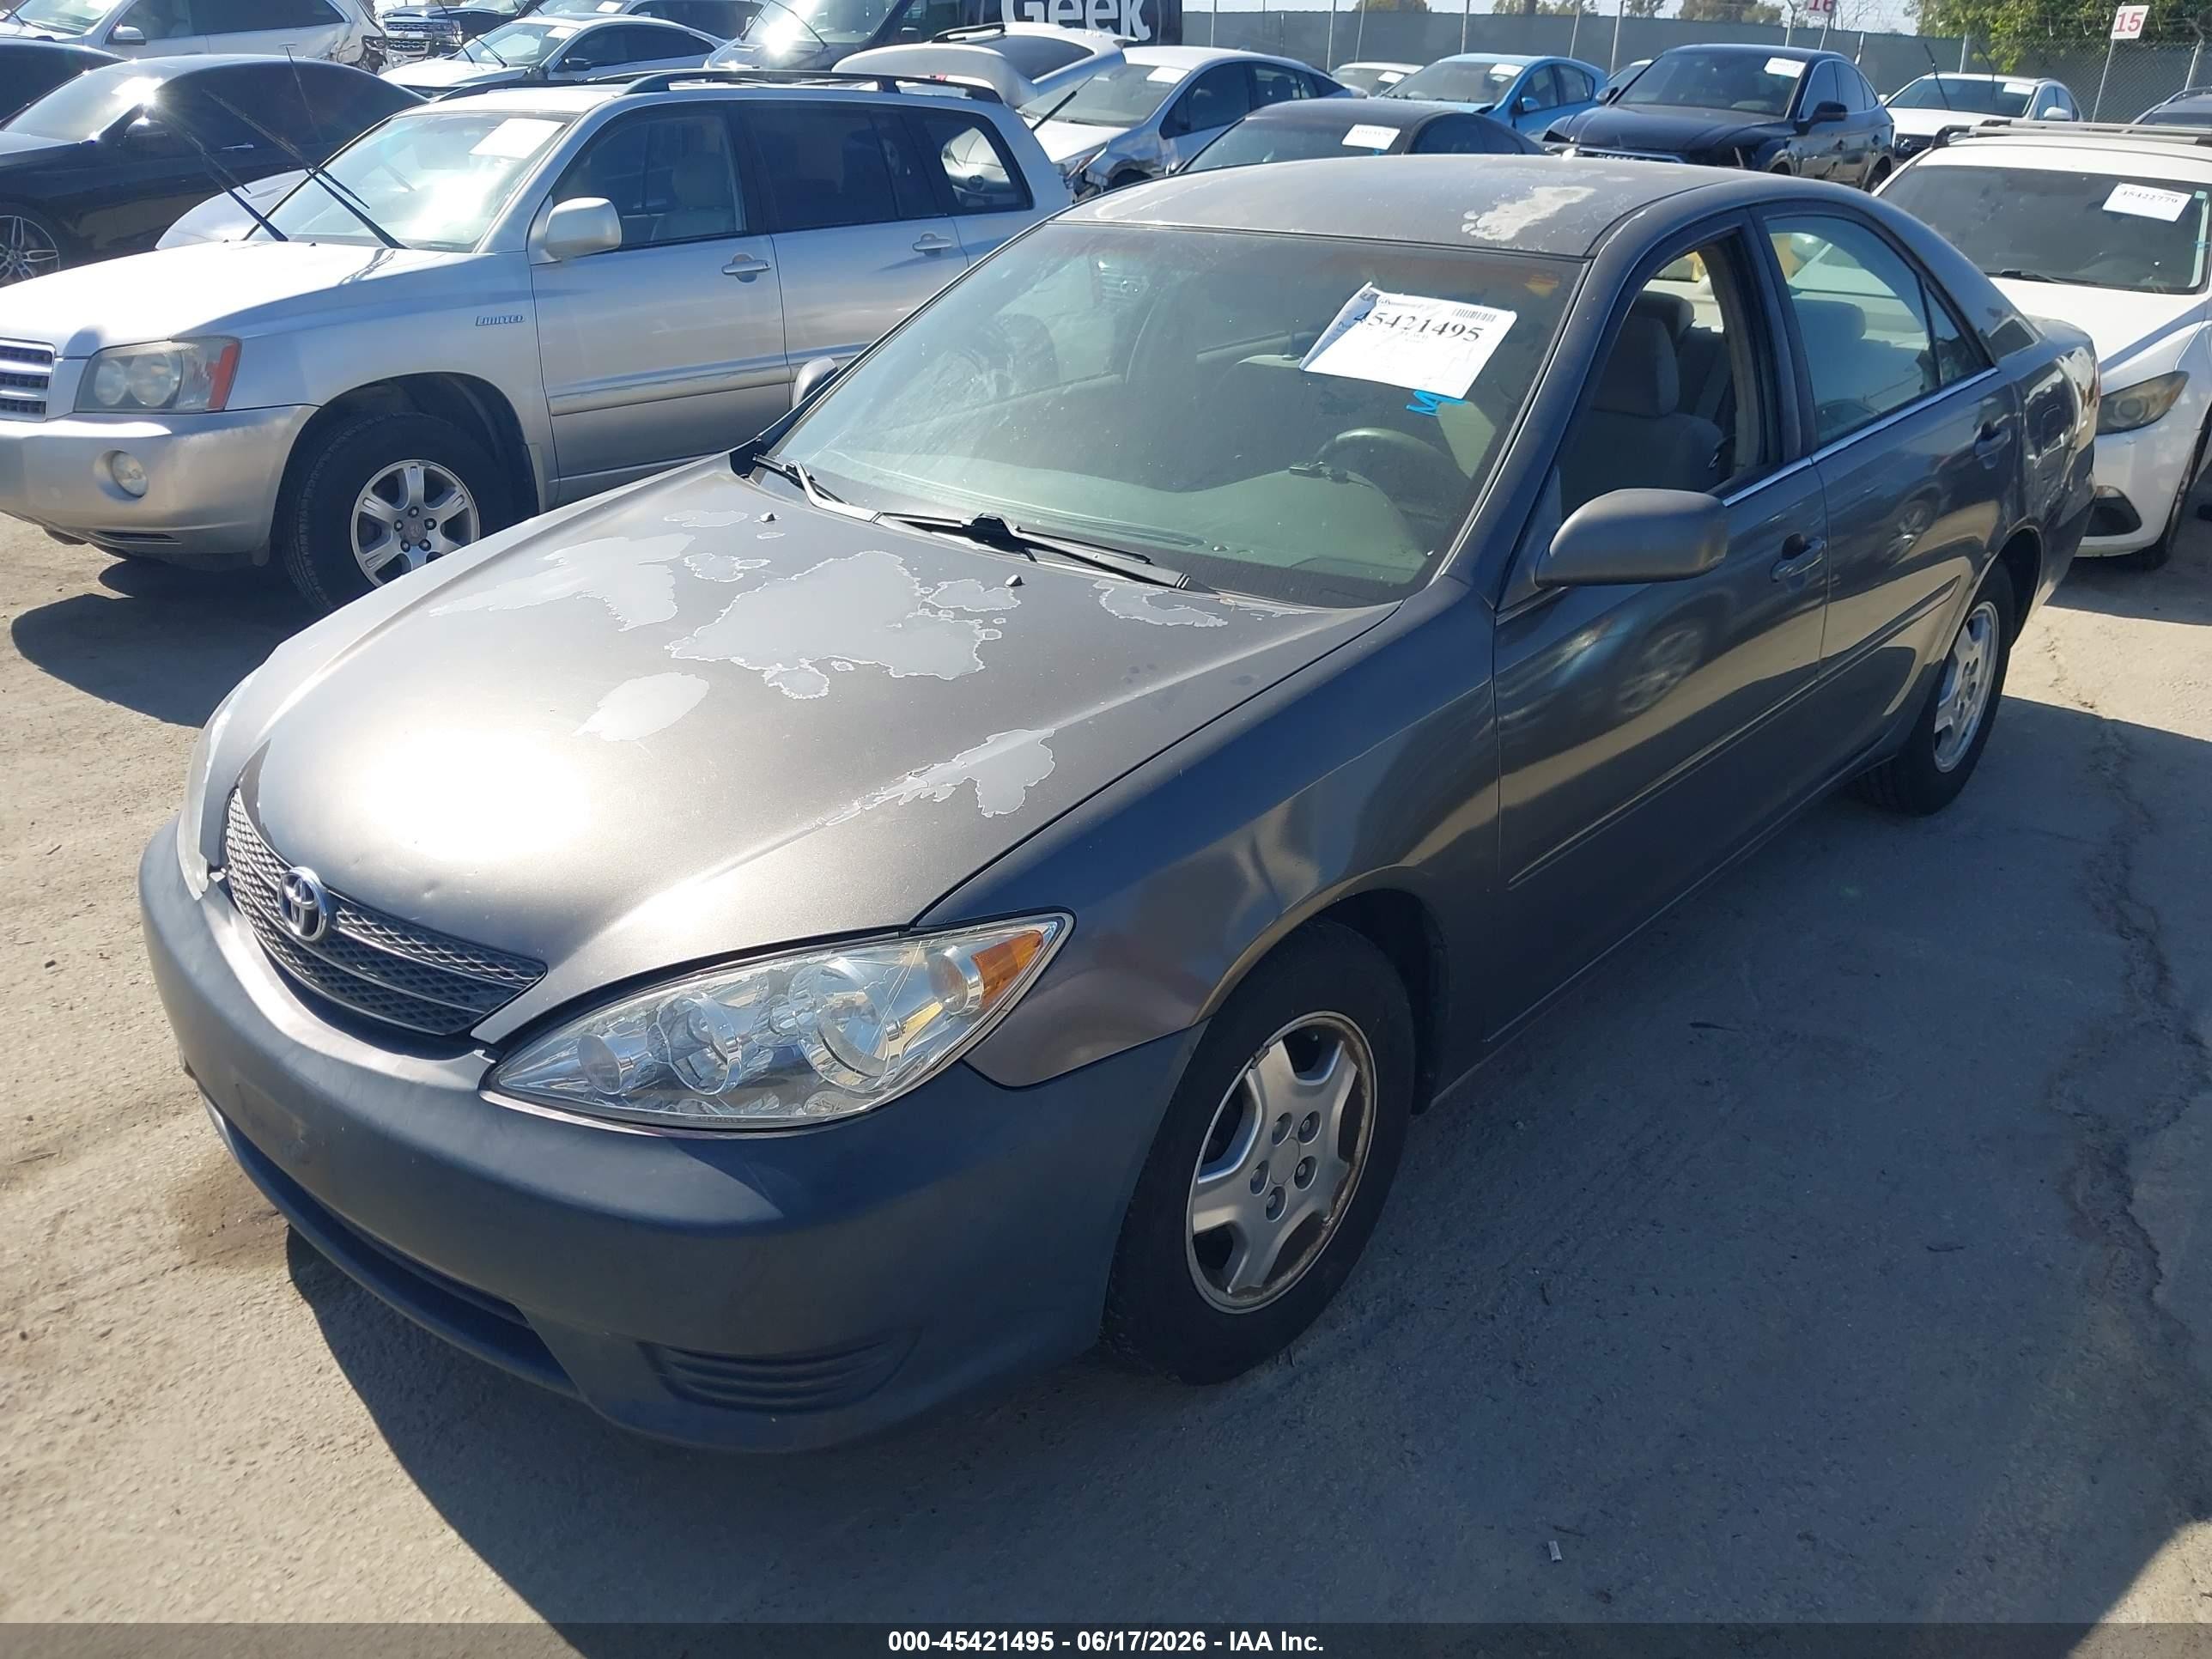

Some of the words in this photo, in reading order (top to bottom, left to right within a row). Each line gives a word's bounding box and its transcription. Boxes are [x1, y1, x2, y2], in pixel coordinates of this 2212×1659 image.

[1808, 0, 1832, 12] 16
[1001, 0, 1152, 40] Geek
[2114, 12, 2144, 32] 15
[1354, 310, 1485, 342] 45421495
